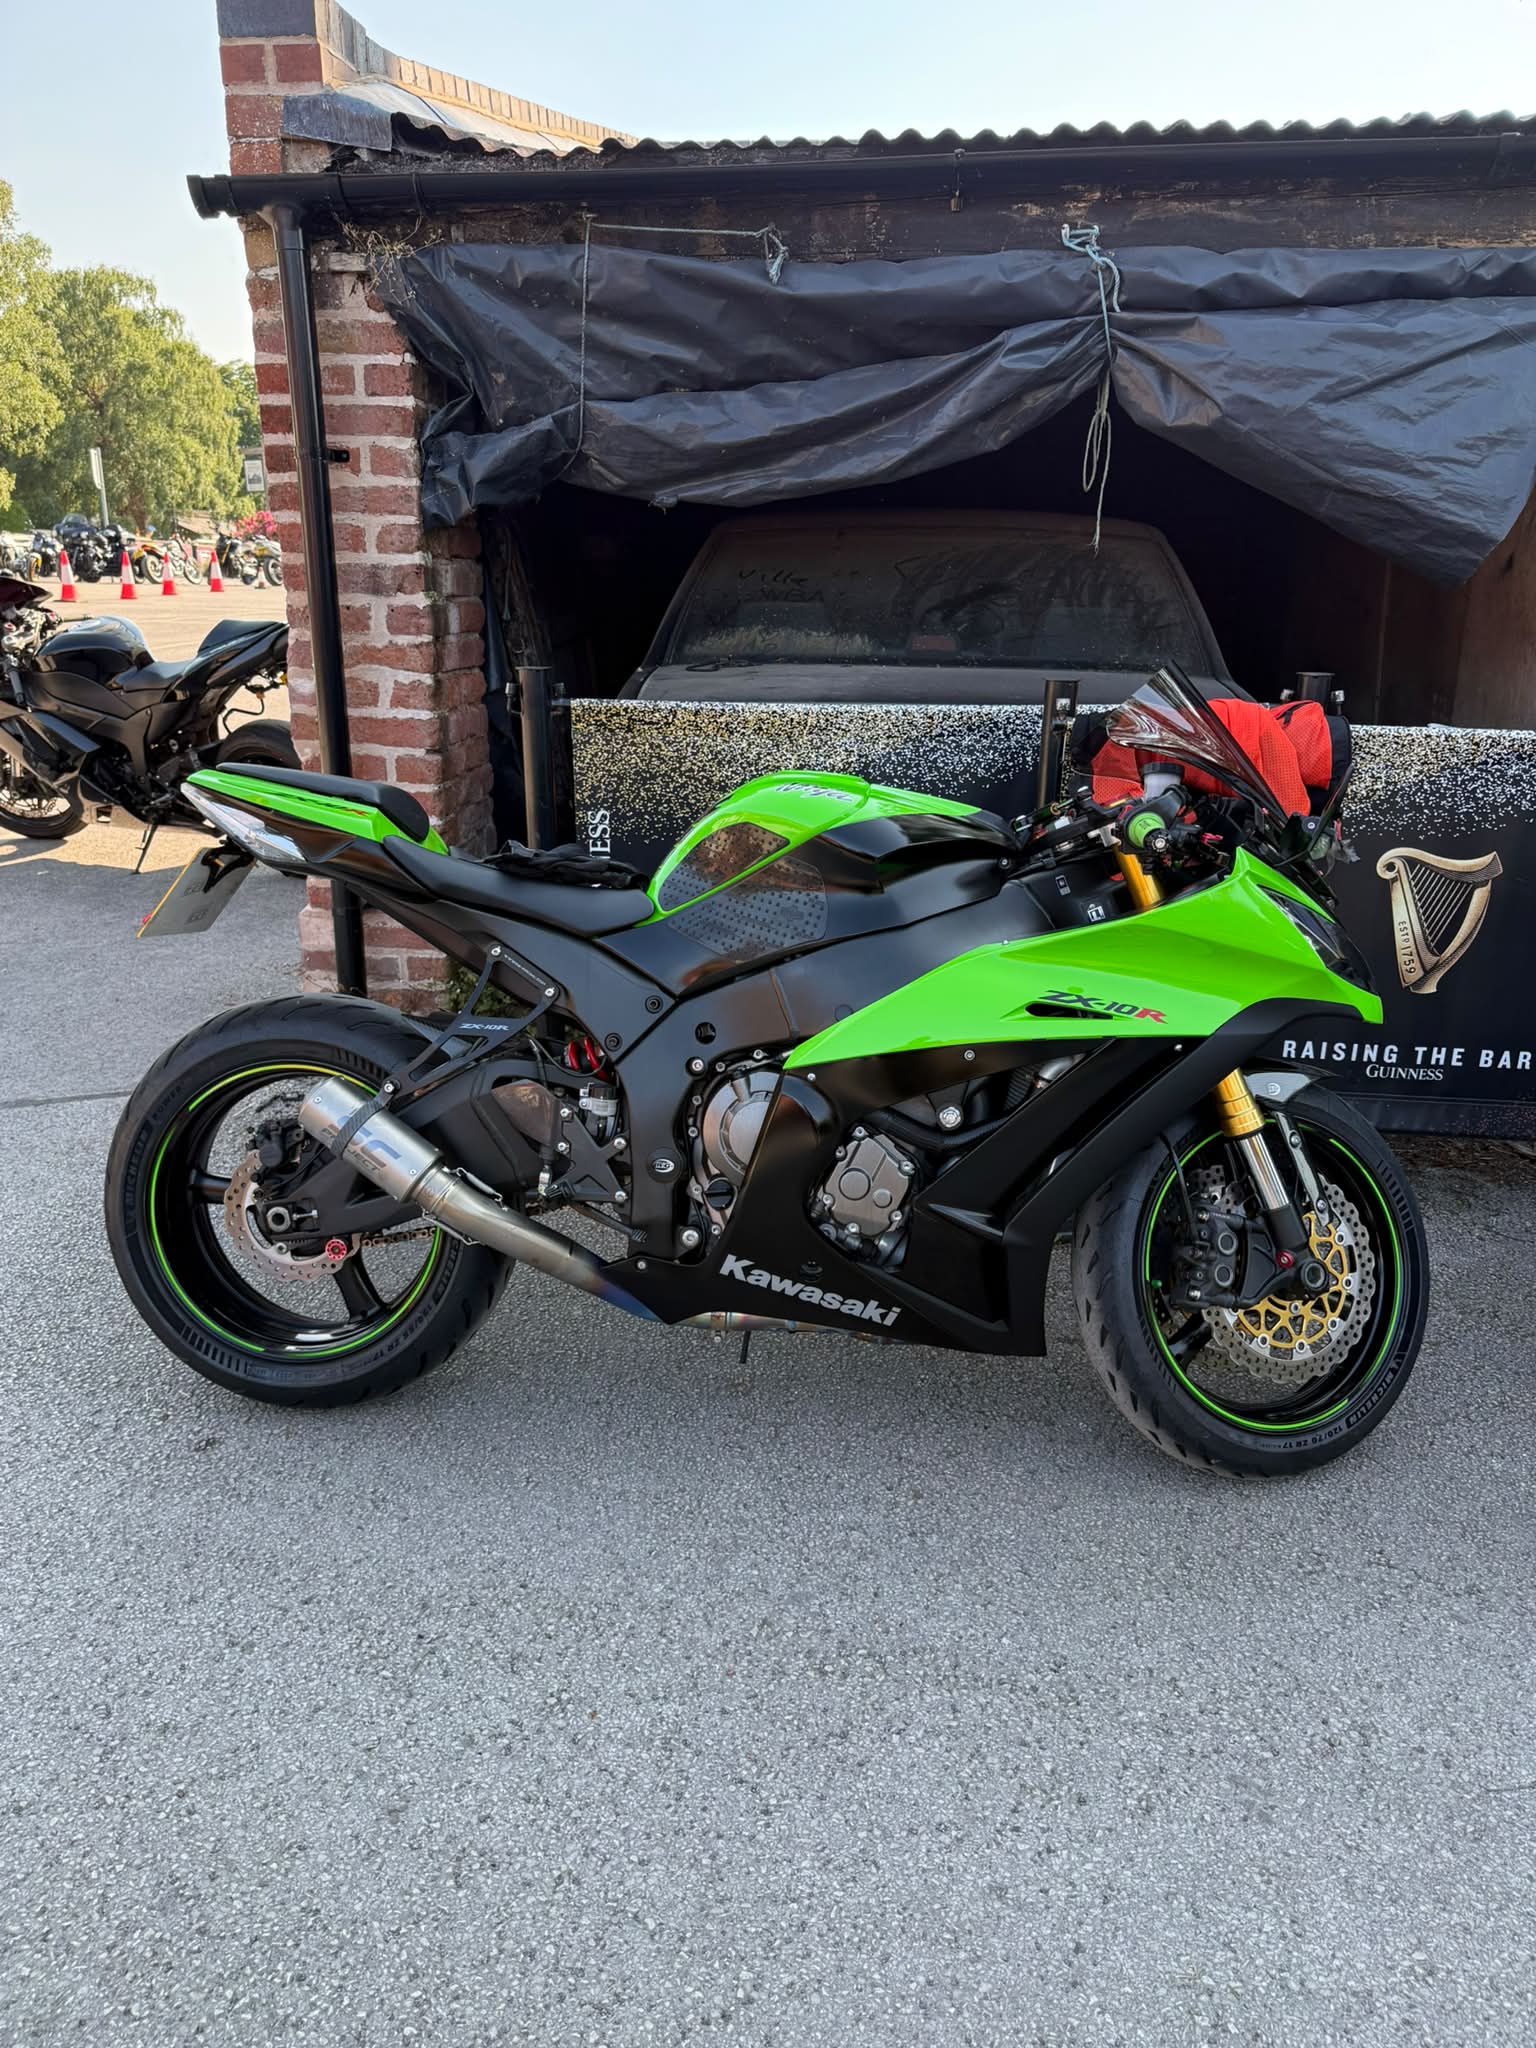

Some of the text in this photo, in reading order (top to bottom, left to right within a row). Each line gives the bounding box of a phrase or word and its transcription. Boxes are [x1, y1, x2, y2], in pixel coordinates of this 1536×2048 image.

[1401, 945, 1417, 974] 1759
[1037, 989, 1169, 1025] ZX-10R
[458, 1022, 510, 1032] ZX-10R
[1282, 1039, 1532, 1070] RAISING THE BAR
[719, 1253, 902, 1327] Kawasaki
[1349, 1367, 1395, 1425] MICHELIN
[1282, 1440, 1294, 1449] 17
[1295, 1439, 1309, 1448] ZR
[1311, 1426, 1344, 1444] 120/70
